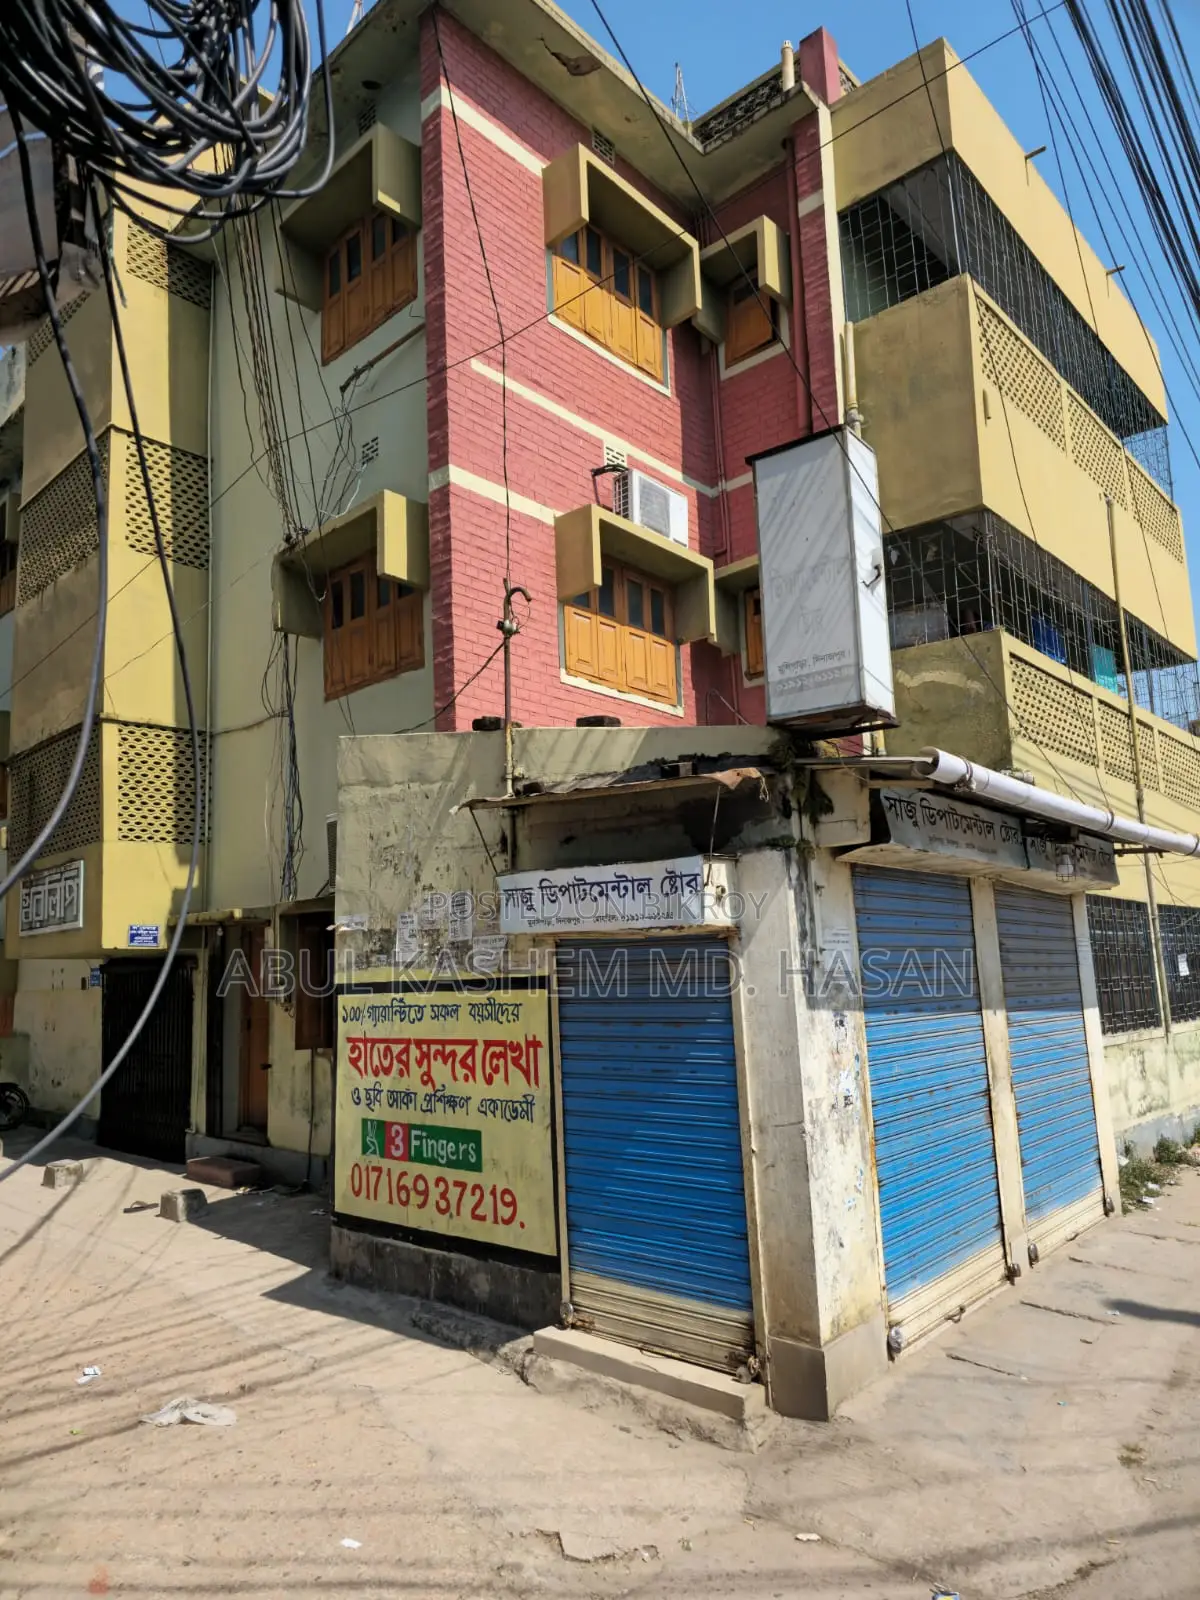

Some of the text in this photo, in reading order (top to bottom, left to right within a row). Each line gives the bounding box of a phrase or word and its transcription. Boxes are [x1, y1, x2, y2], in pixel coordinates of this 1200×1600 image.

[884, 795, 919, 830] সাজু
[503, 886, 537, 912] সাজু
[430, 1004, 461, 1023] সকল
[346, 1031, 543, 1091] হাতের সুন্দর লেখা
[351, 1087, 361, 1106] ও
[364, 1081, 383, 1112] ছবি
[390, 1124, 477, 1164] 3 Fingers
[351, 1162, 526, 1229] 01716937219.
